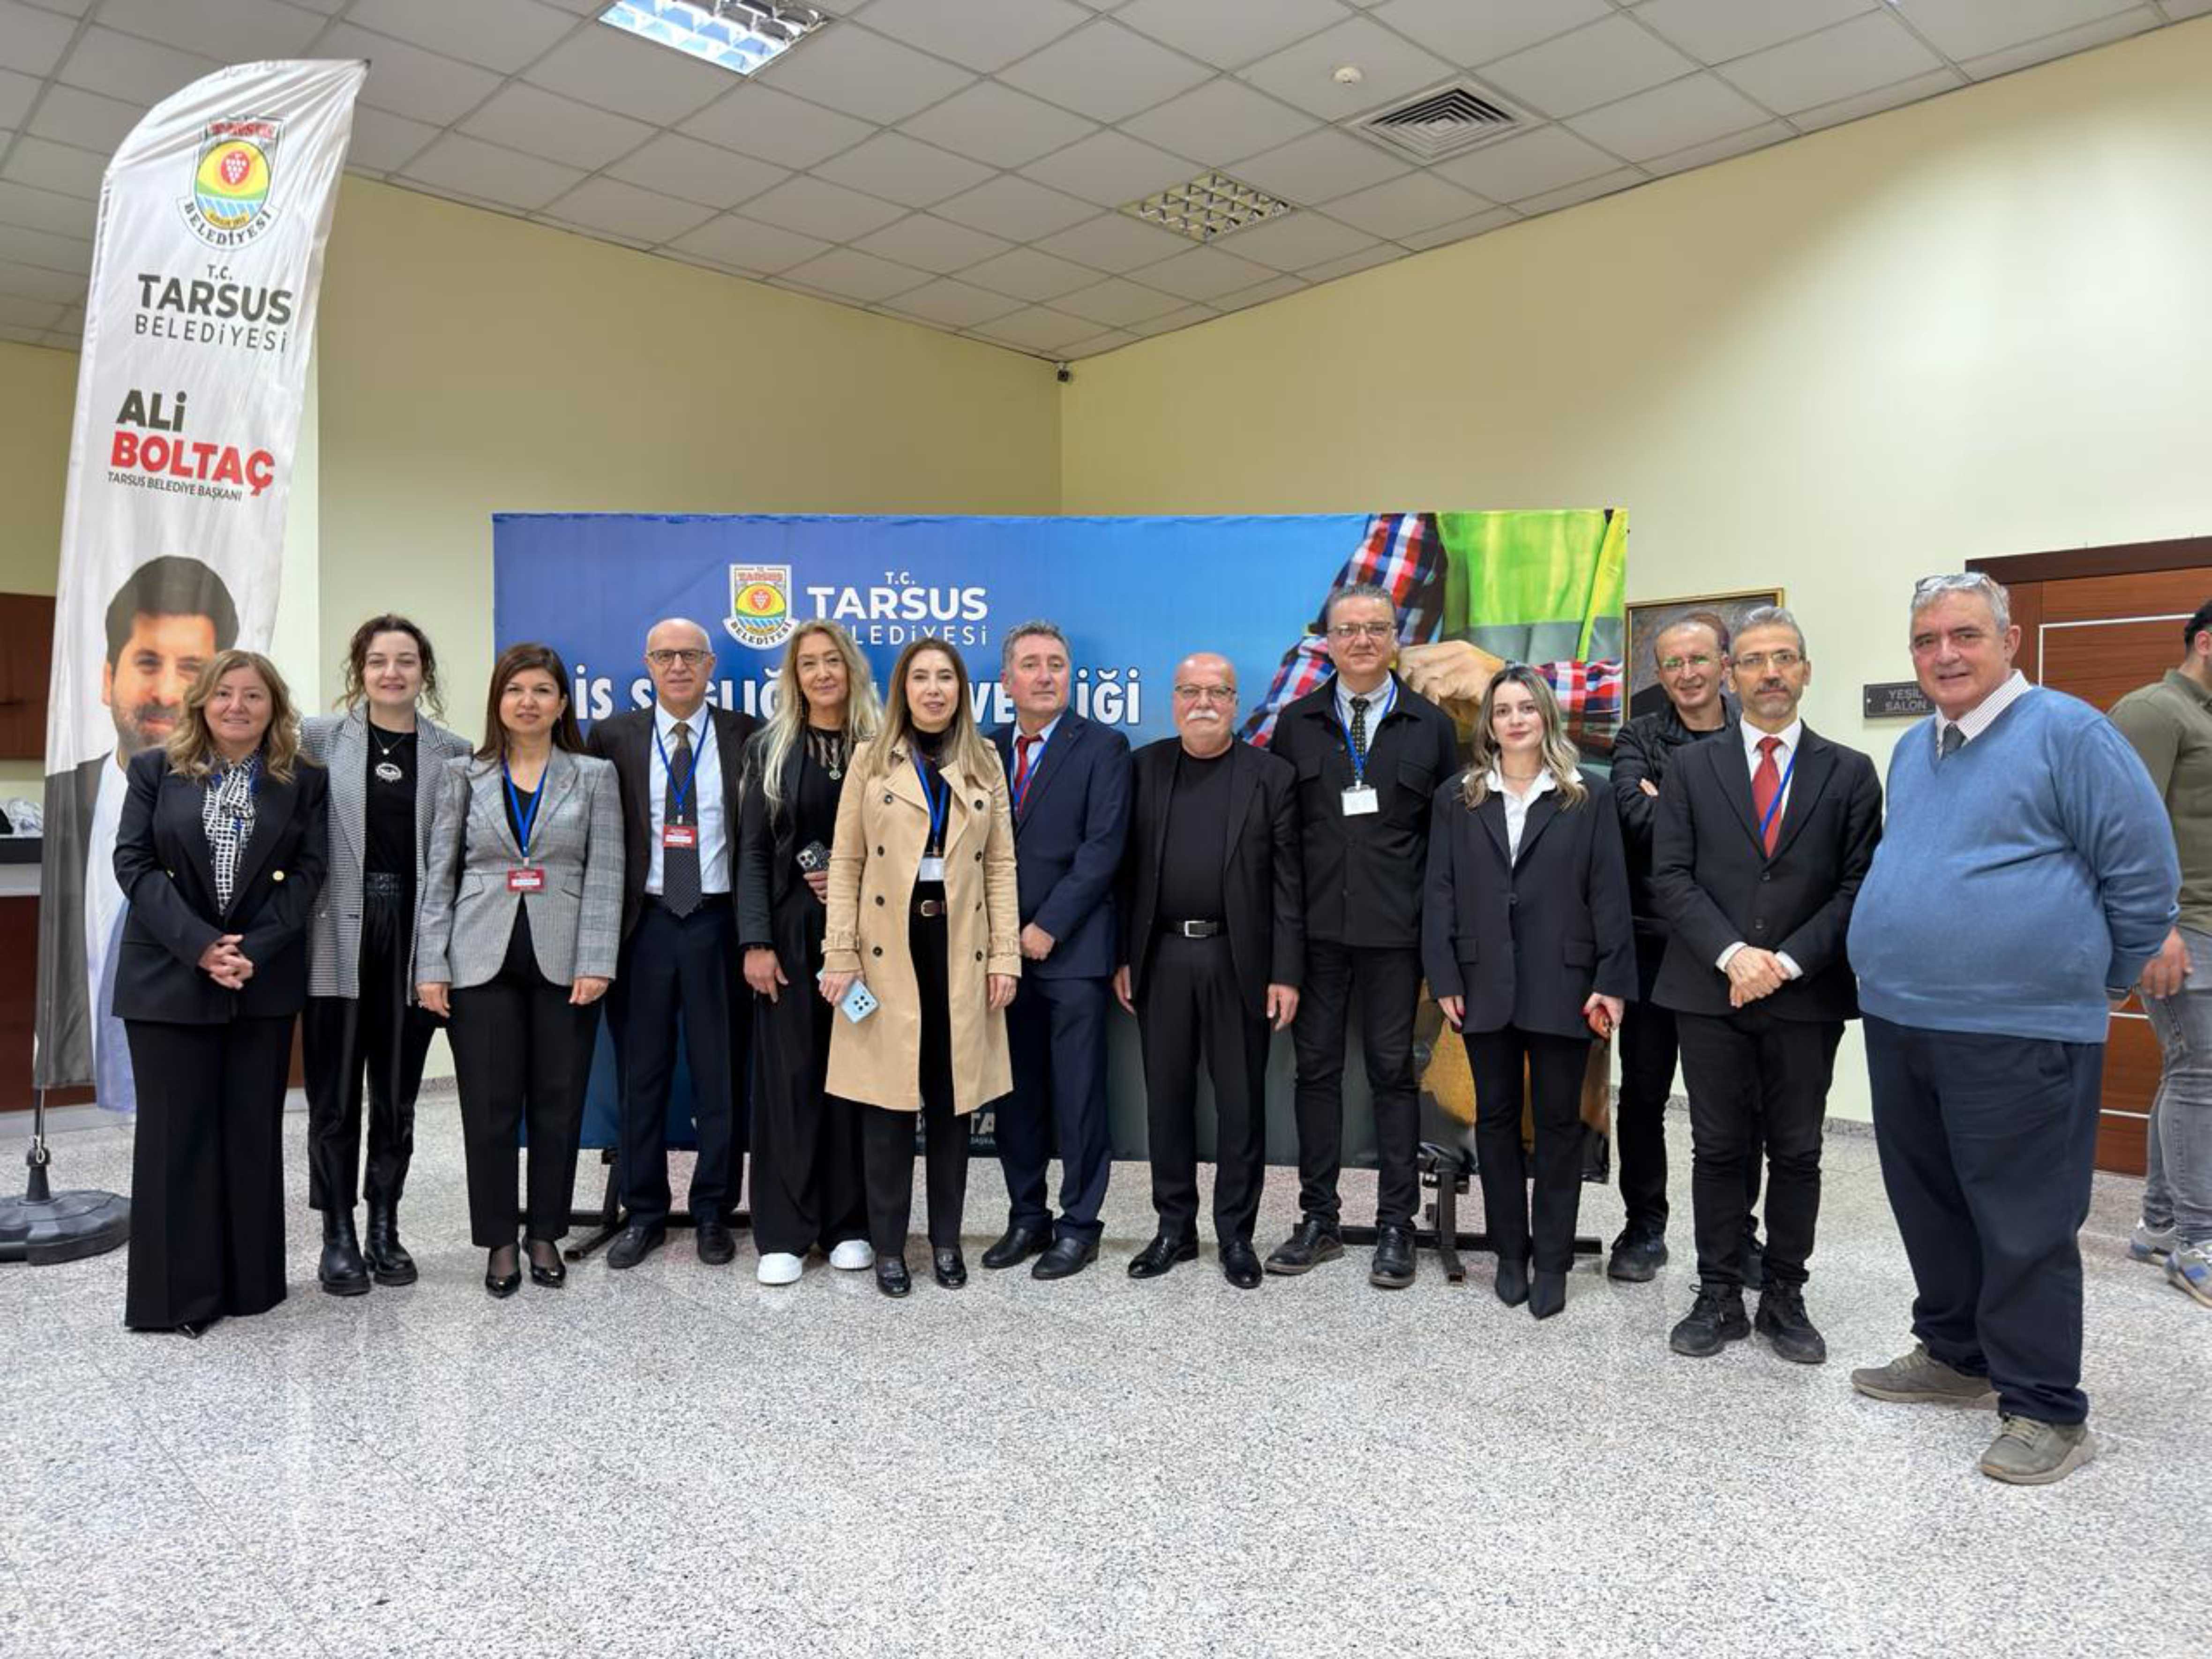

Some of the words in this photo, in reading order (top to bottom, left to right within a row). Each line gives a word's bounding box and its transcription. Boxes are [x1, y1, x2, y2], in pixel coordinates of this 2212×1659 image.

[207, 264, 232, 280] T.C.
[138, 274, 292, 325] TARSUS
[111, 431, 275, 496] BOLTAÇ
[108, 471, 145, 488] TARSUS
[197, 485, 242, 501] BAŞKANI
[885, 572, 915, 585] T.C.
[807, 587, 988, 621] TARSUS
